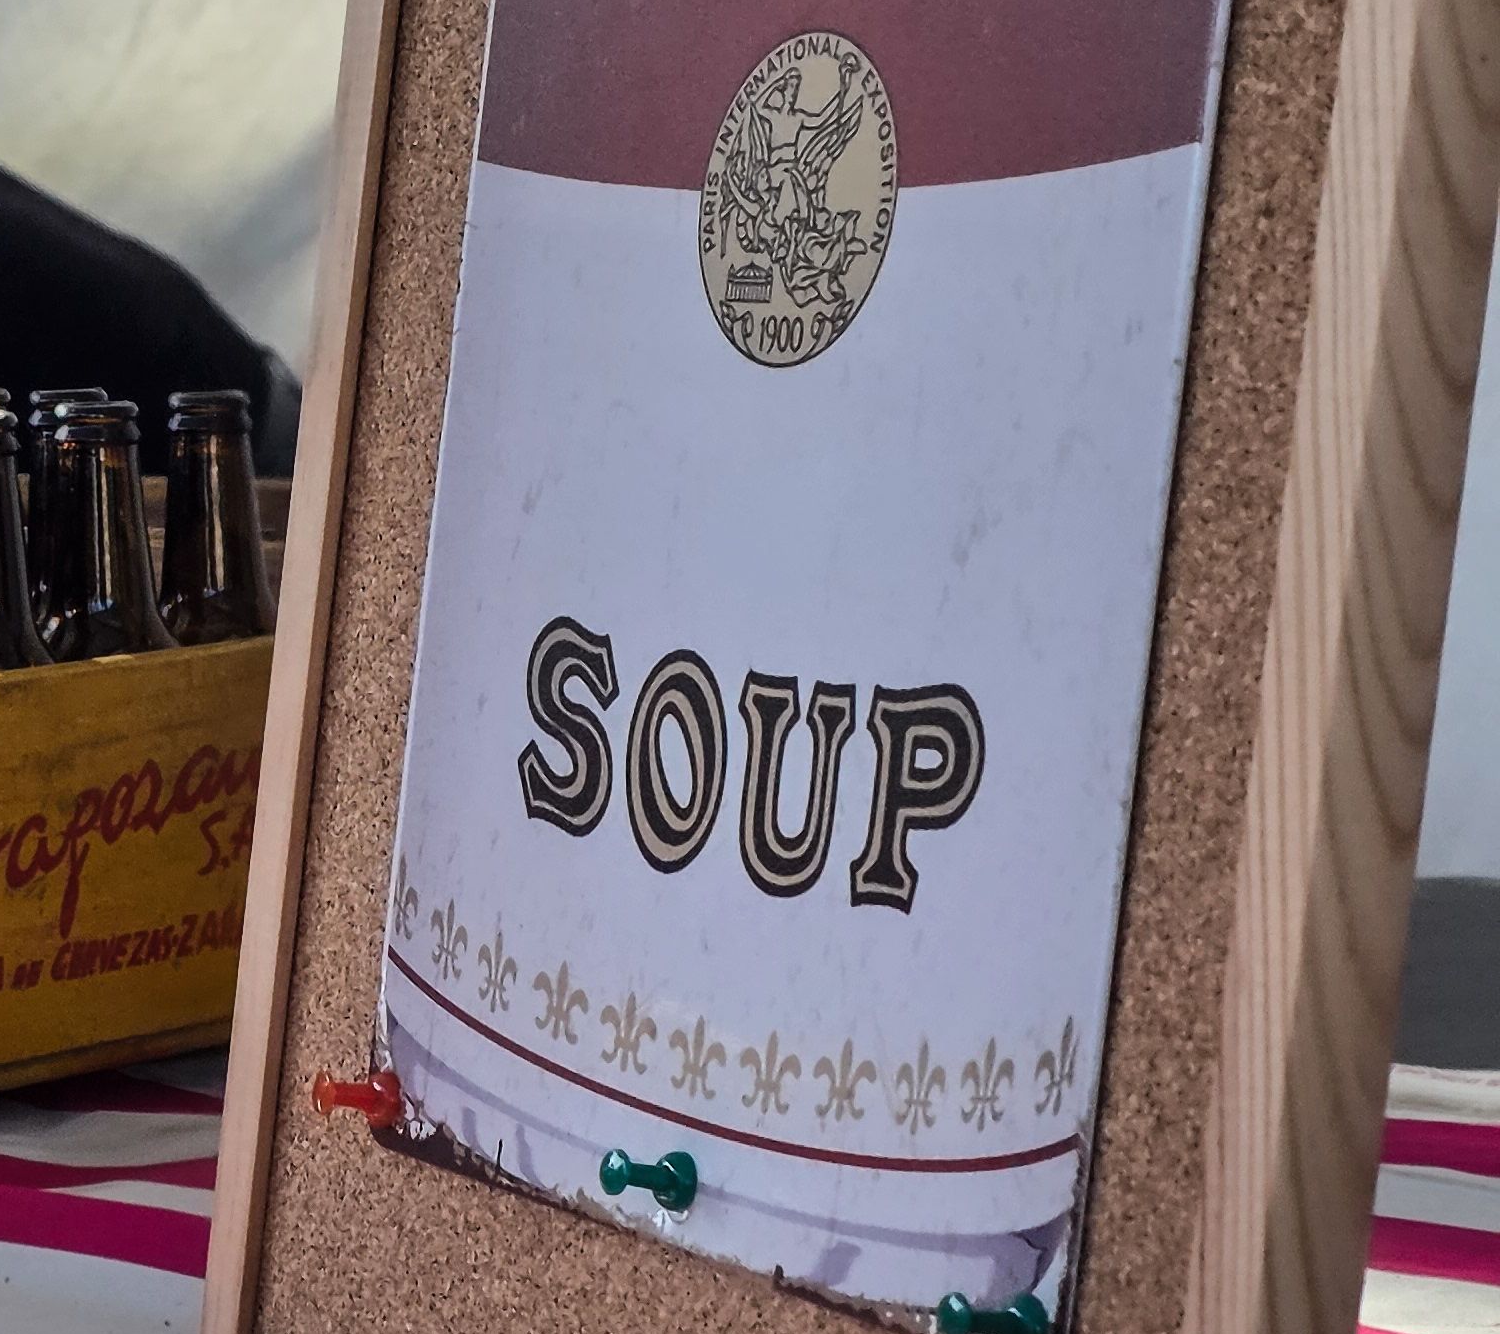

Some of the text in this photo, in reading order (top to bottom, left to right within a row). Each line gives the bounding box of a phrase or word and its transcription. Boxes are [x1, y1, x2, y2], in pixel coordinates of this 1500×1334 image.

[703, 36, 895, 254] PARIS INTERNATIONAL EXPOSITION
[759, 316, 804, 355] 1900
[517, 616, 985, 915] SOUP
